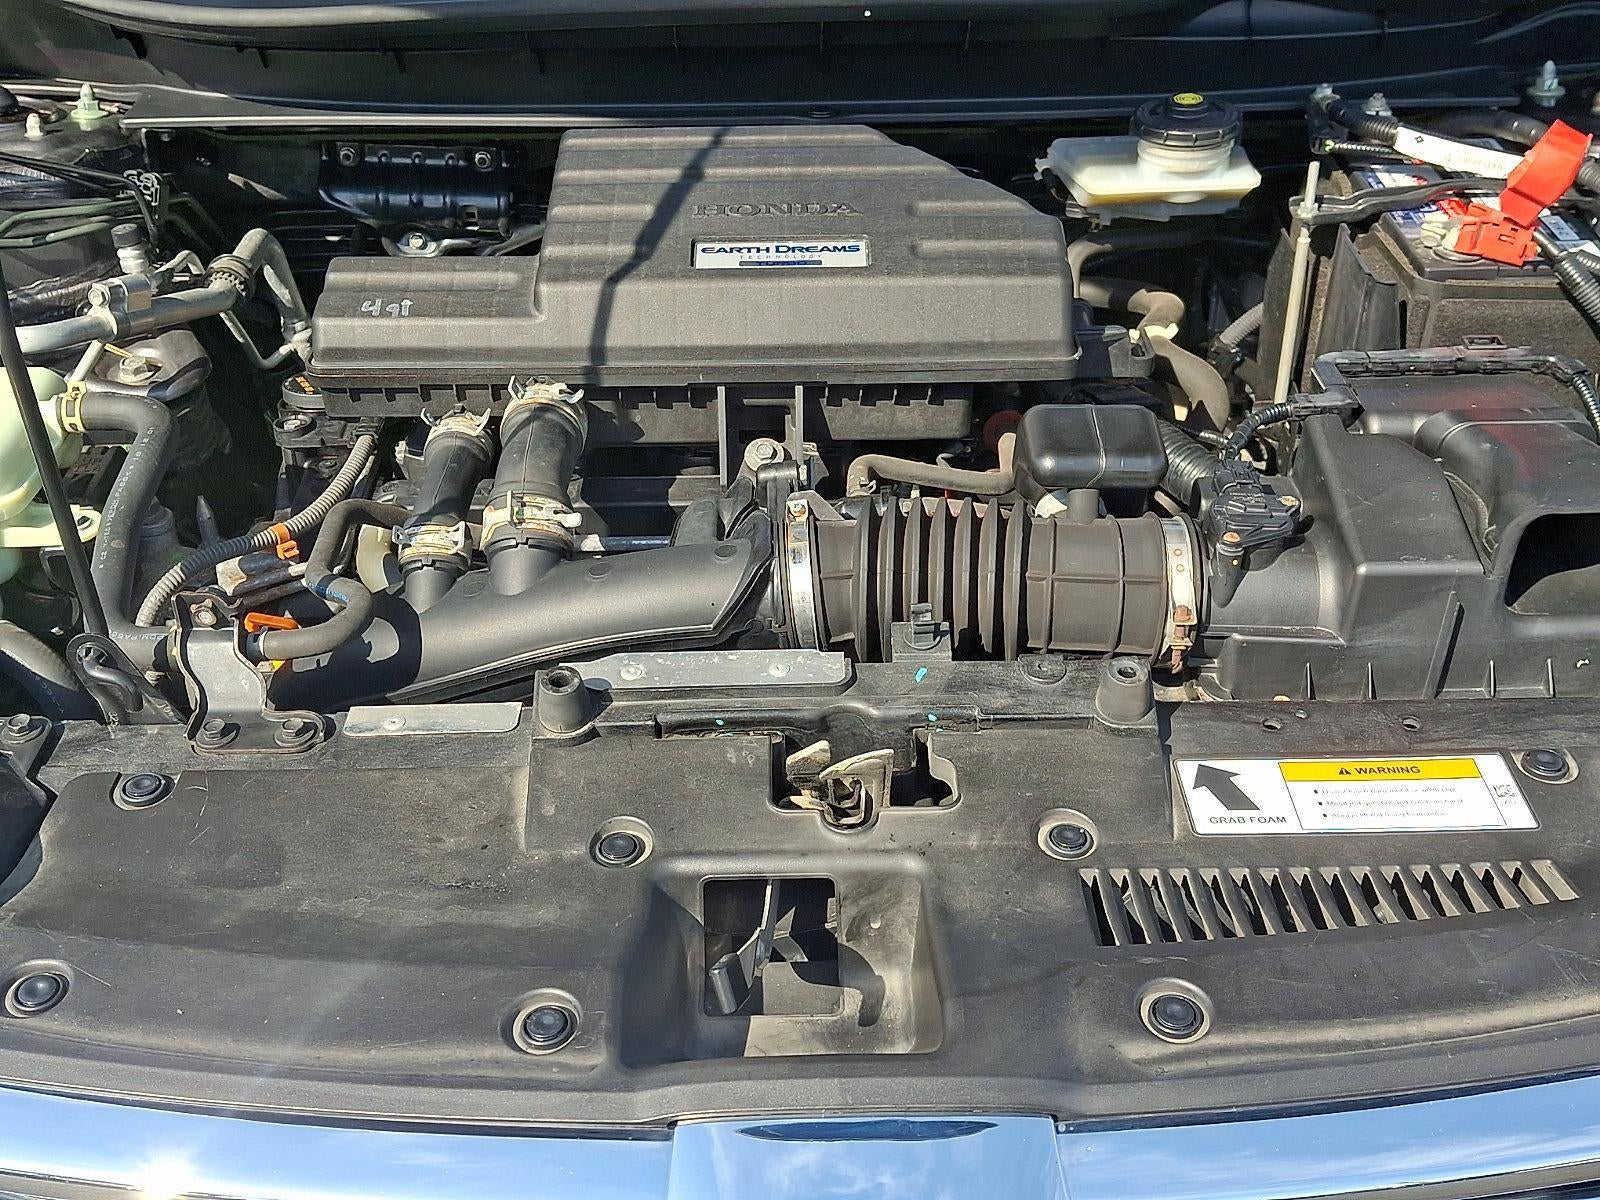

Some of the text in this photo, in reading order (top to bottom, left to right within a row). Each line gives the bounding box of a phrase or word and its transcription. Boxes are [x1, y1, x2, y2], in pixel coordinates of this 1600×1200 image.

[692, 202, 863, 218] HONDA
[701, 244, 861, 254] EARTH DREAMS
[1355, 765, 1421, 775] WARNING
[1209, 815, 1287, 825] GRAB FOAM
